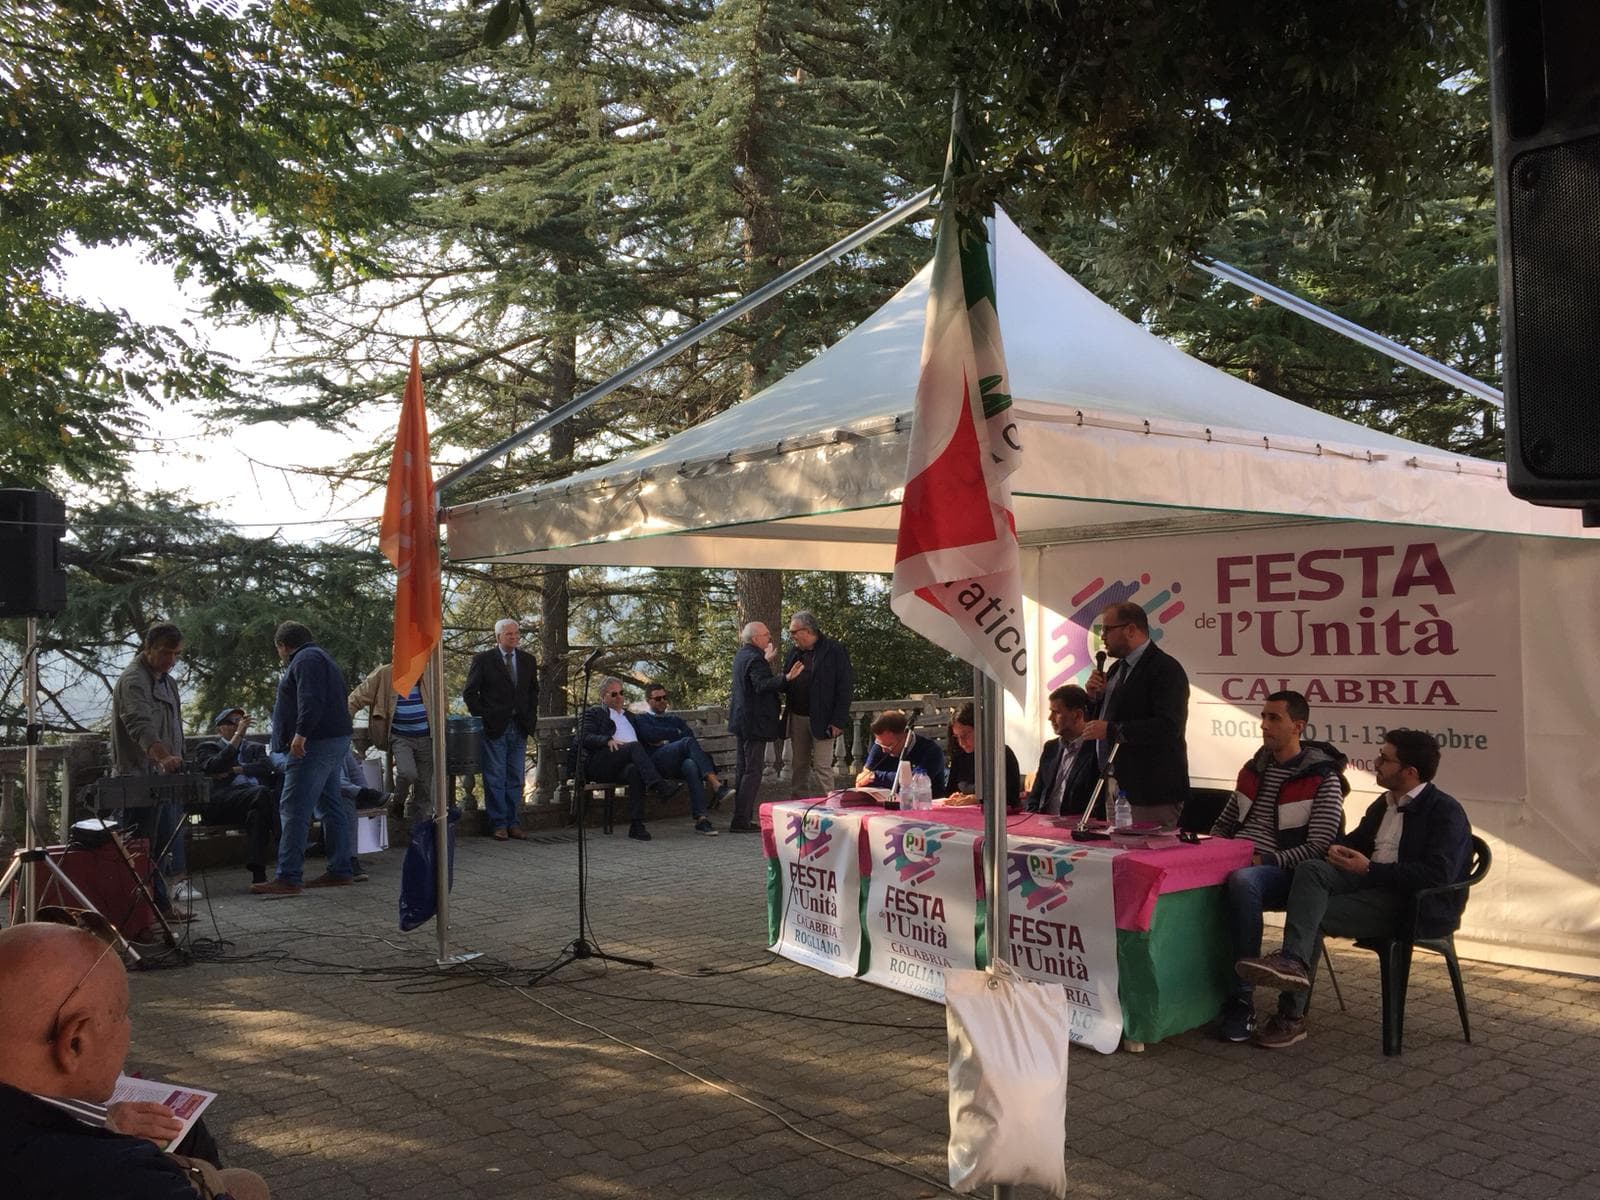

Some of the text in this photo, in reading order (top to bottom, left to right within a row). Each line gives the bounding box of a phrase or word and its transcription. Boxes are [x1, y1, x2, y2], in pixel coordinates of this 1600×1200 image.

[1216, 542, 1456, 605] FESTA
[944, 578, 1027, 676] atico
[1194, 603, 1460, 658] de l'Unità
[1211, 719, 1317, 741] ROGLO
[1400, 727, 1489, 750] obre
[789, 862, 838, 894] FESTA
[885, 884, 947, 923] FESTA
[794, 928, 841, 957] ROGLIANO
[1008, 914, 1086, 954] FESTA
[889, 957, 945, 985] ROGLIAN
[891, 942, 953, 969] CALABRIA
